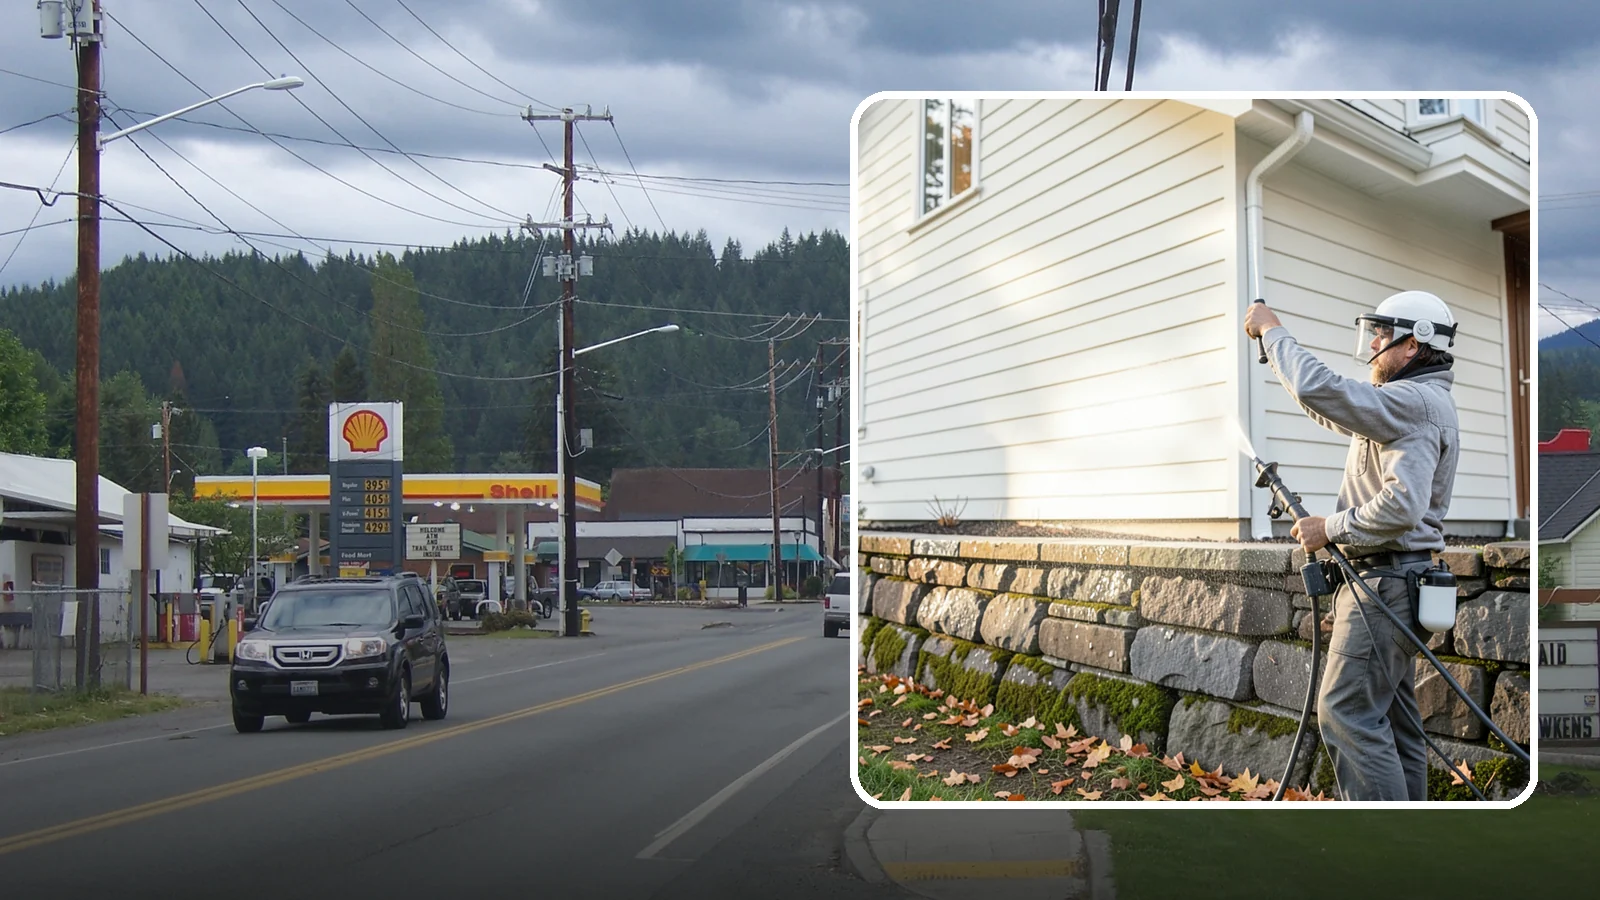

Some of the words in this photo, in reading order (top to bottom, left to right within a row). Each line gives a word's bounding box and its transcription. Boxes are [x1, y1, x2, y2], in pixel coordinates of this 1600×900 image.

[366, 480, 384, 490] 395
[490, 484, 547, 499] Shell
[366, 494, 384, 504] 405
[366, 508, 384, 518] 415
[366, 522, 384, 532] 429
